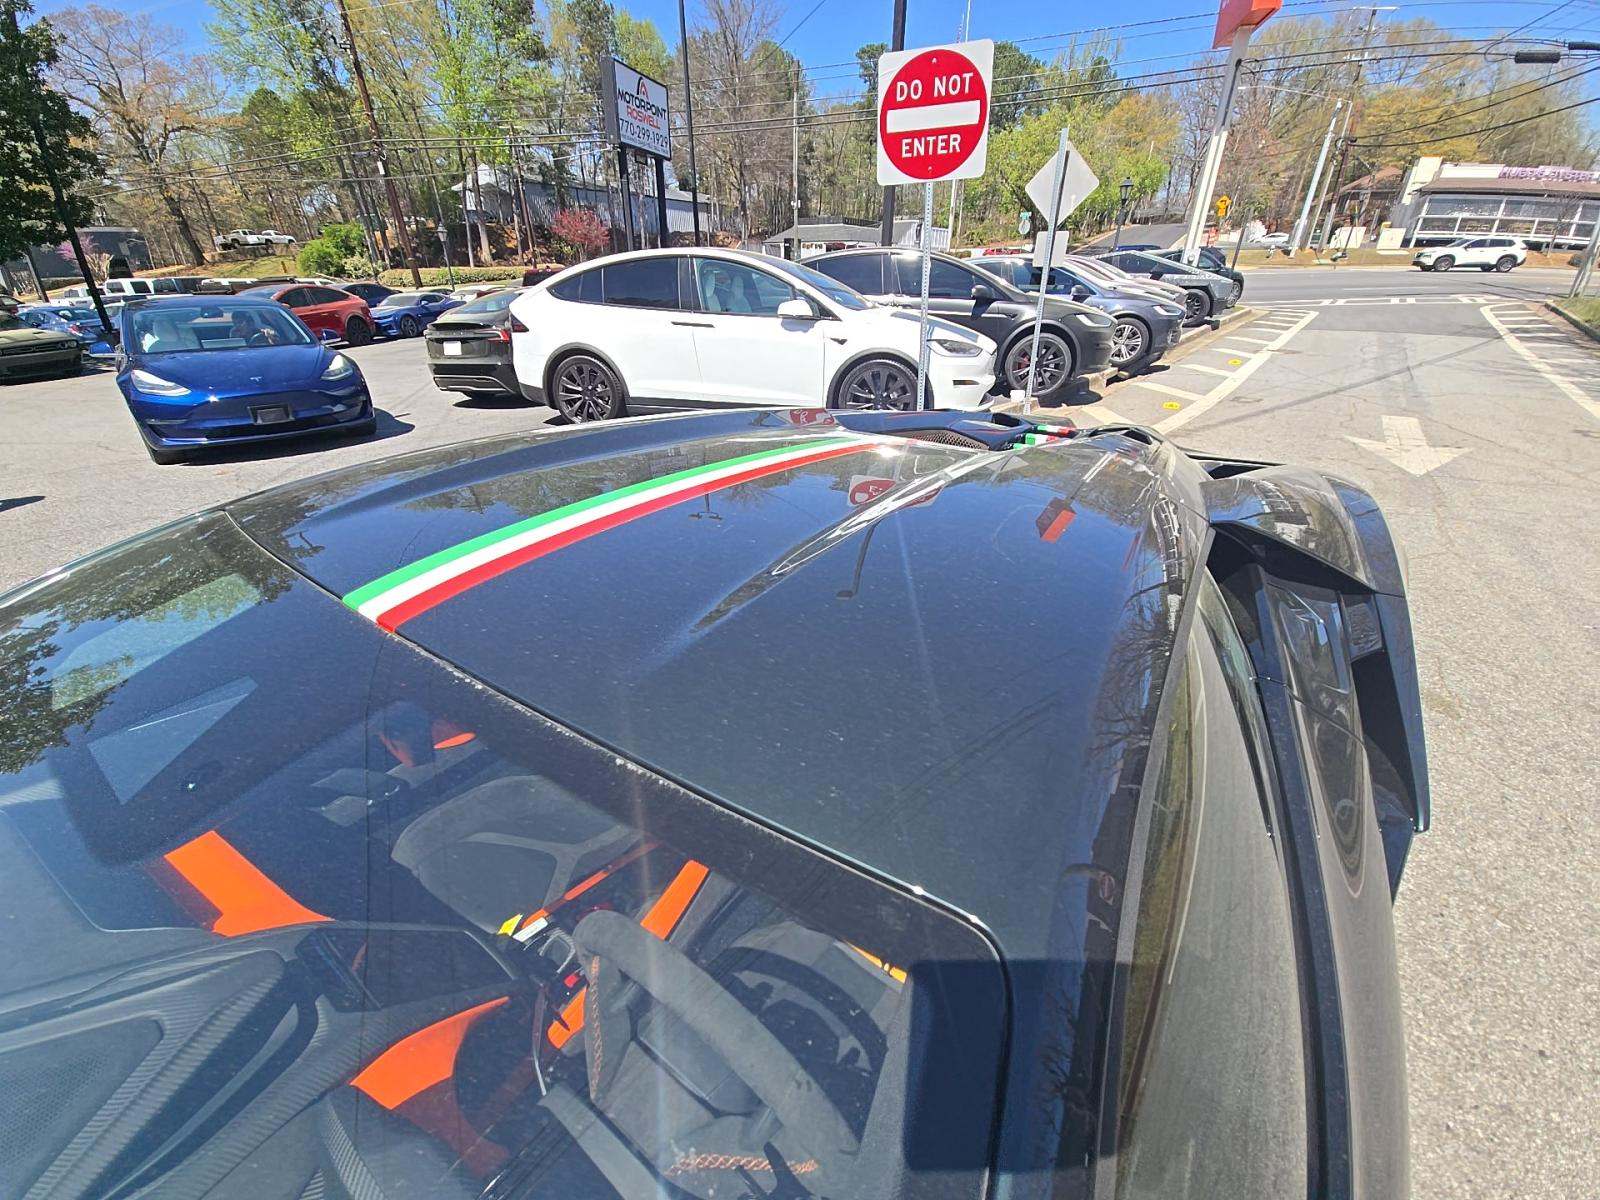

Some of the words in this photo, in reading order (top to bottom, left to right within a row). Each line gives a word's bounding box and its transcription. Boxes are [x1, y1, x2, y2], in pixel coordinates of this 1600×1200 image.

[896, 79, 923, 102] DO
[933, 72, 974, 98] NOT
[618, 88, 667, 121] MOTORPOINT
[626, 105, 661, 130] ROSWELL
[901, 134, 962, 158] ENTER
